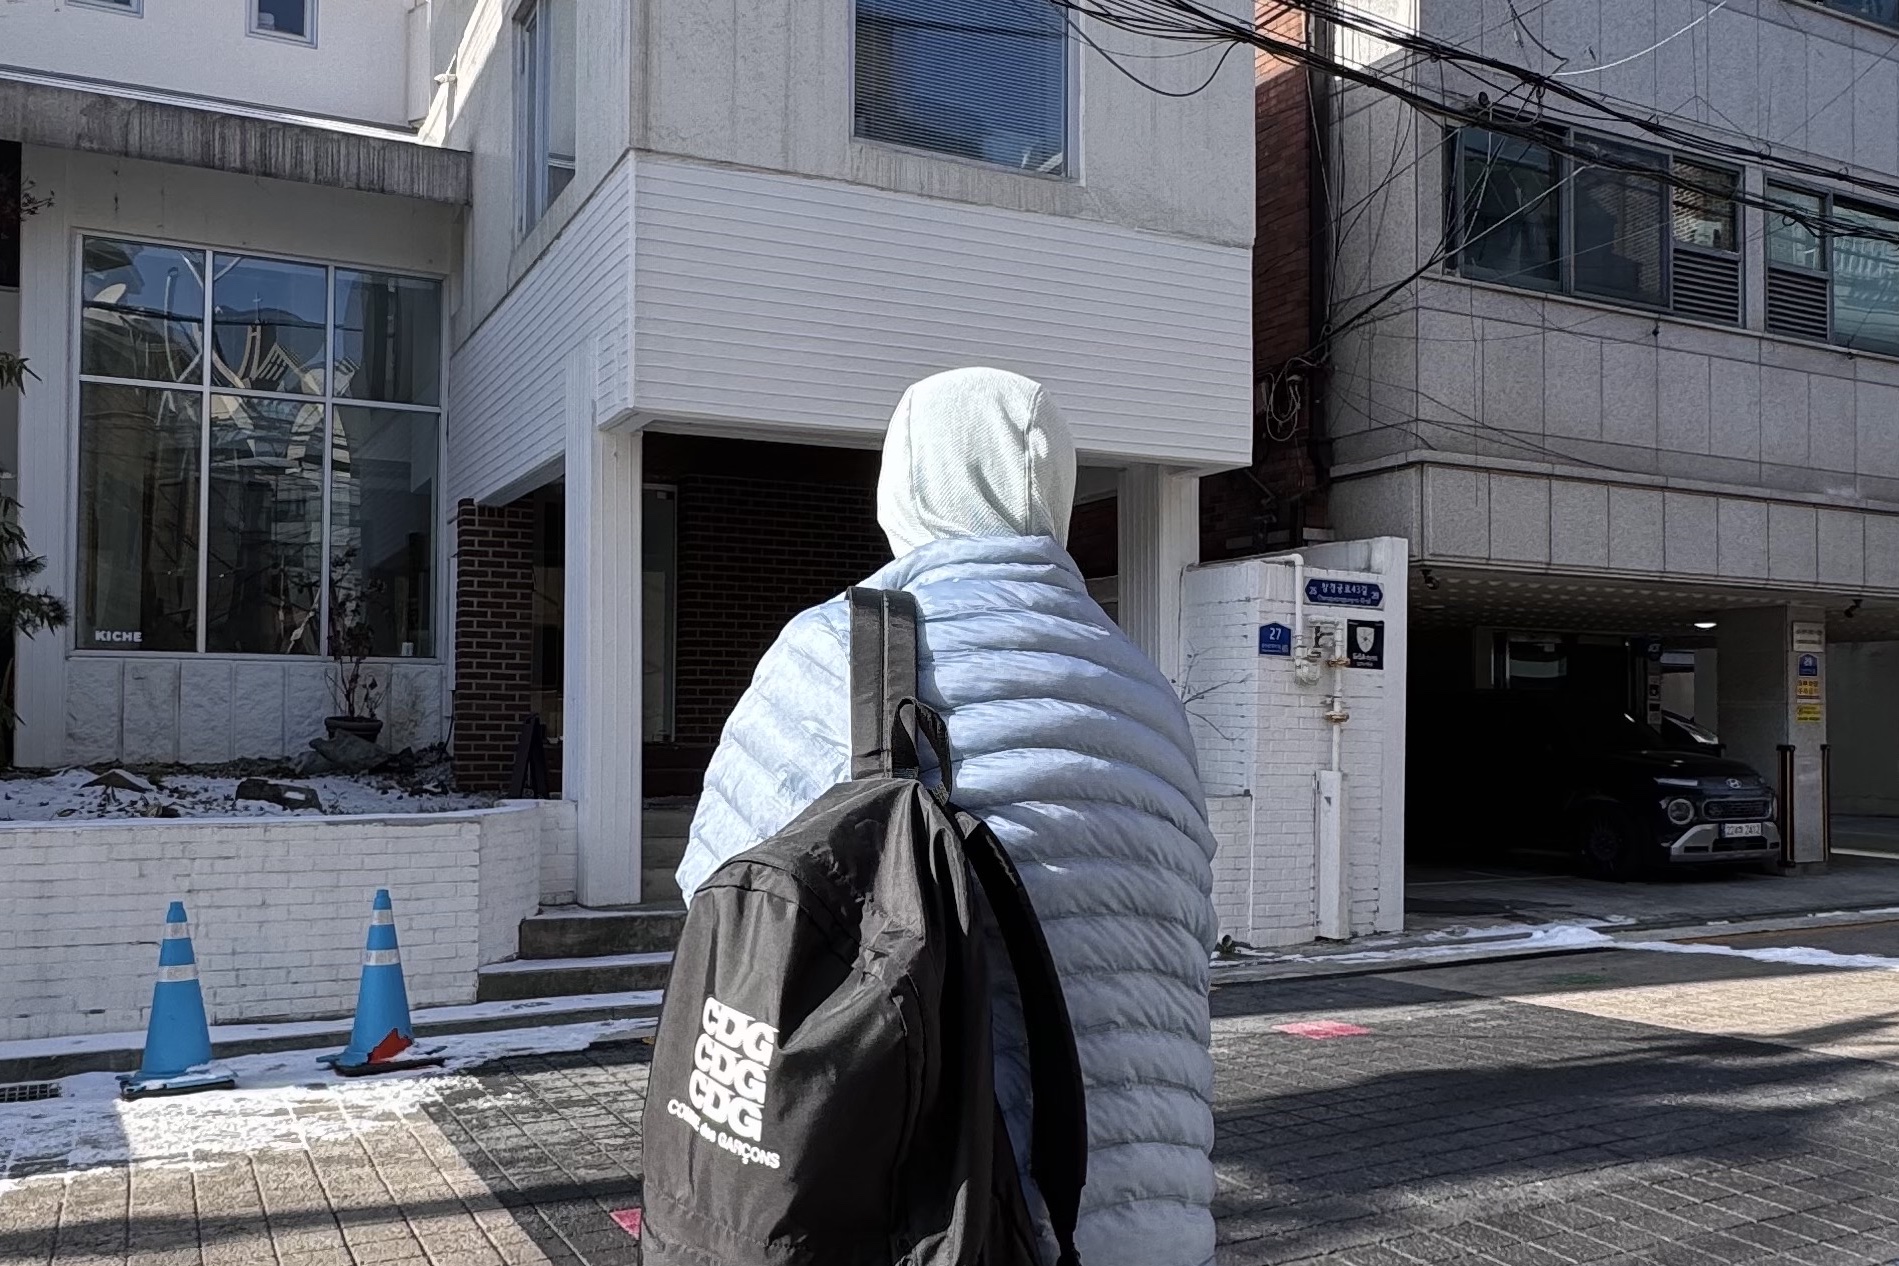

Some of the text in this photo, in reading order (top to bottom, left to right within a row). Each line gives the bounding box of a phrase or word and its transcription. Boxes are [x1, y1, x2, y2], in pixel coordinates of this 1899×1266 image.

[1309, 586, 1317, 595] 25
[95, 630, 142, 642] KICHE
[1269, 627, 1282, 641] 27
[702, 996, 780, 1067] CDG
[694, 1033, 771, 1105] CDG
[688, 1069, 765, 1142] CDG
[717, 1131, 781, 1169] GARÇONS
